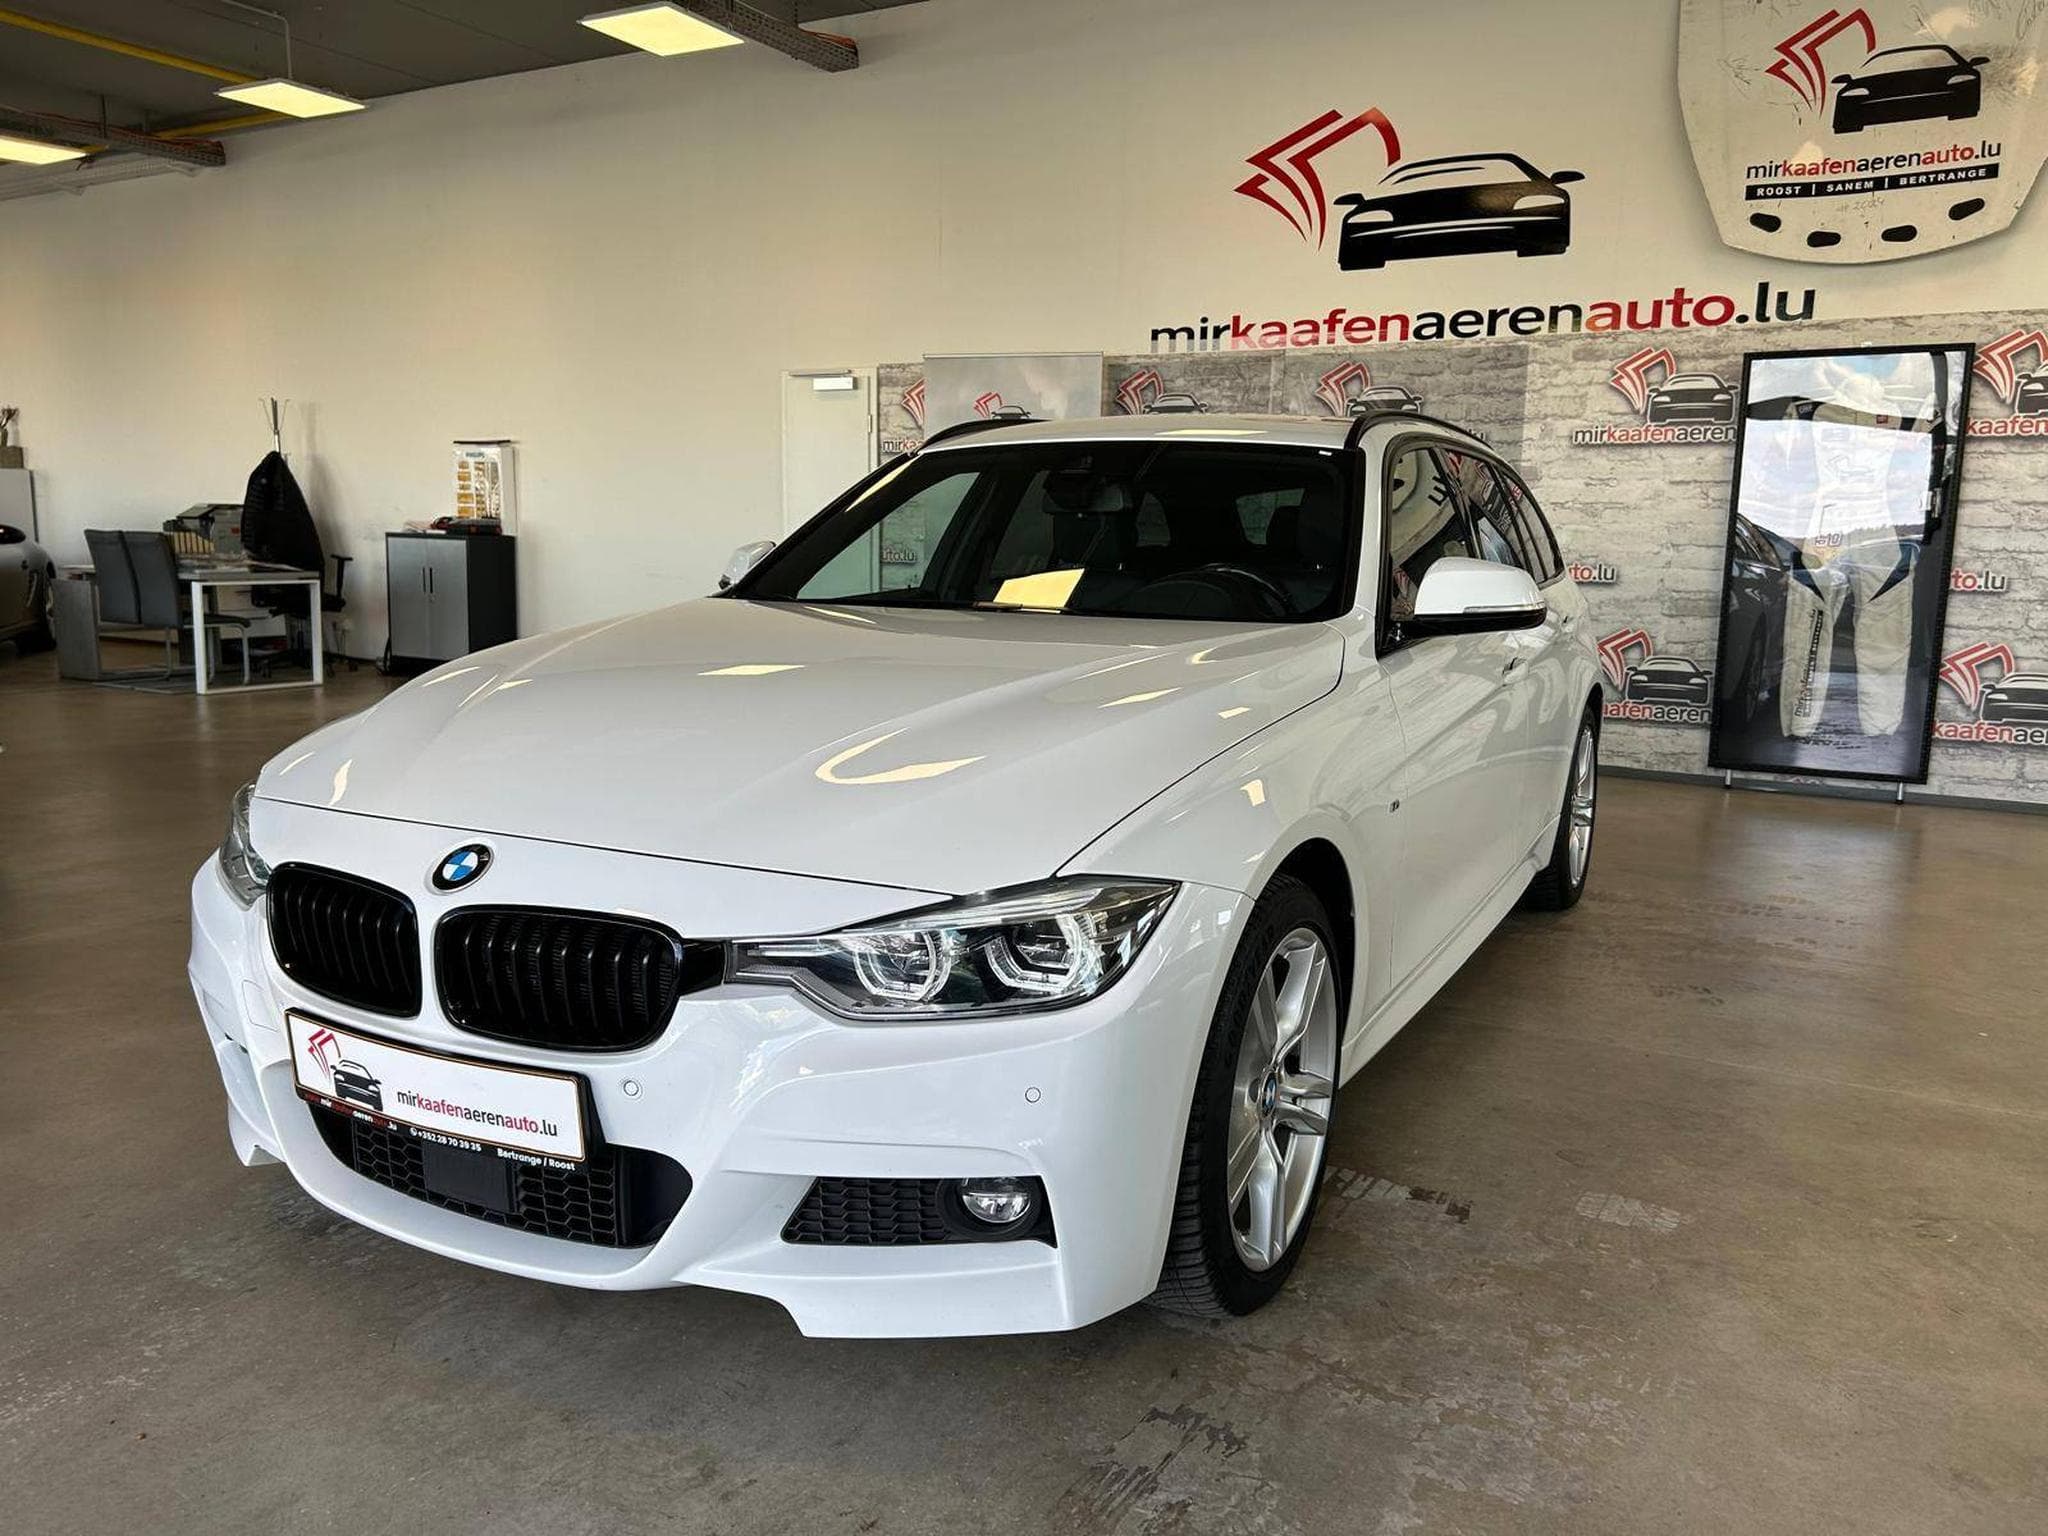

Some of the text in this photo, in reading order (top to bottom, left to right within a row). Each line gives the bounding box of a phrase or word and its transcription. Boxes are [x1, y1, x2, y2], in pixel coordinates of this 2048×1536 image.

[1746, 140, 2001, 179] mirkaafenaerenauto.lu
[1756, 186, 1801, 197] ROOST
[1826, 181, 1874, 193] SANEM
[1899, 168, 1987, 185] BERTRANGE
[1151, 282, 1816, 351] mirkaafenaerenauto.lu
[397, 1090, 558, 1137] mirkaafenaerenauto.lu
[497, 1148, 542, 1166] Bertrange
[548, 1159, 576, 1171] Roost
